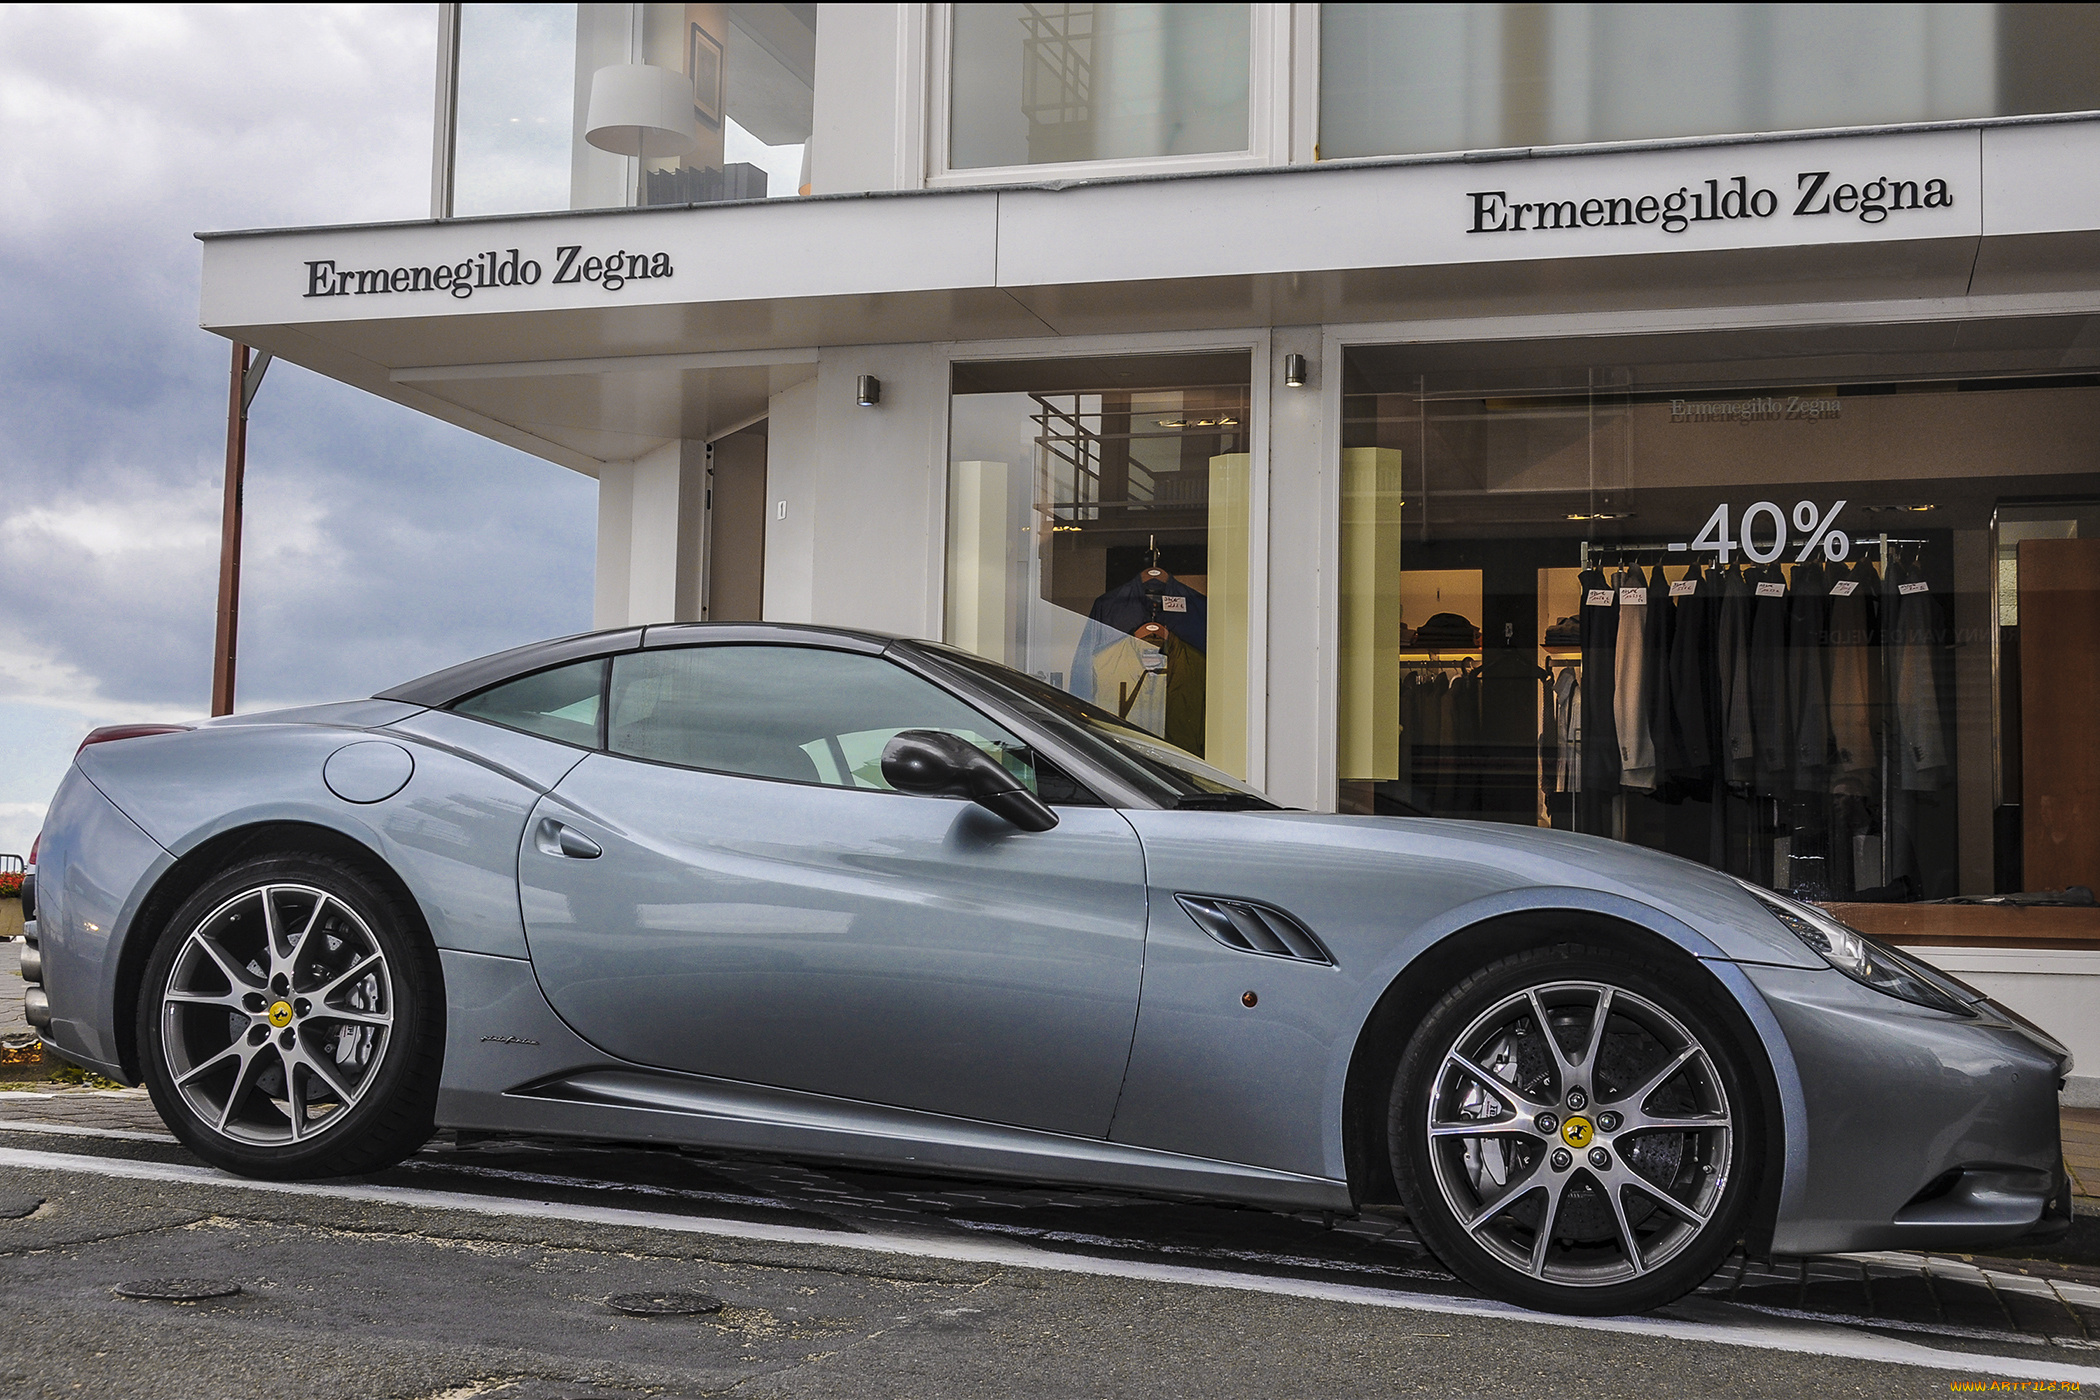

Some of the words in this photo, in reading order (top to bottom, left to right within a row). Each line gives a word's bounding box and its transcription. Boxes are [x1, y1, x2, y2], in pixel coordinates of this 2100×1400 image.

[1465, 175, 1778, 233] Ermenegildo
[1792, 171, 1953, 224] Zegna
[302, 248, 542, 299] Ermenegildo
[552, 244, 674, 291] Zegna
[1669, 397, 1782, 418] Ermenegildo
[1787, 396, 1842, 416] Zegna
[1667, 499, 1850, 564] -40%
